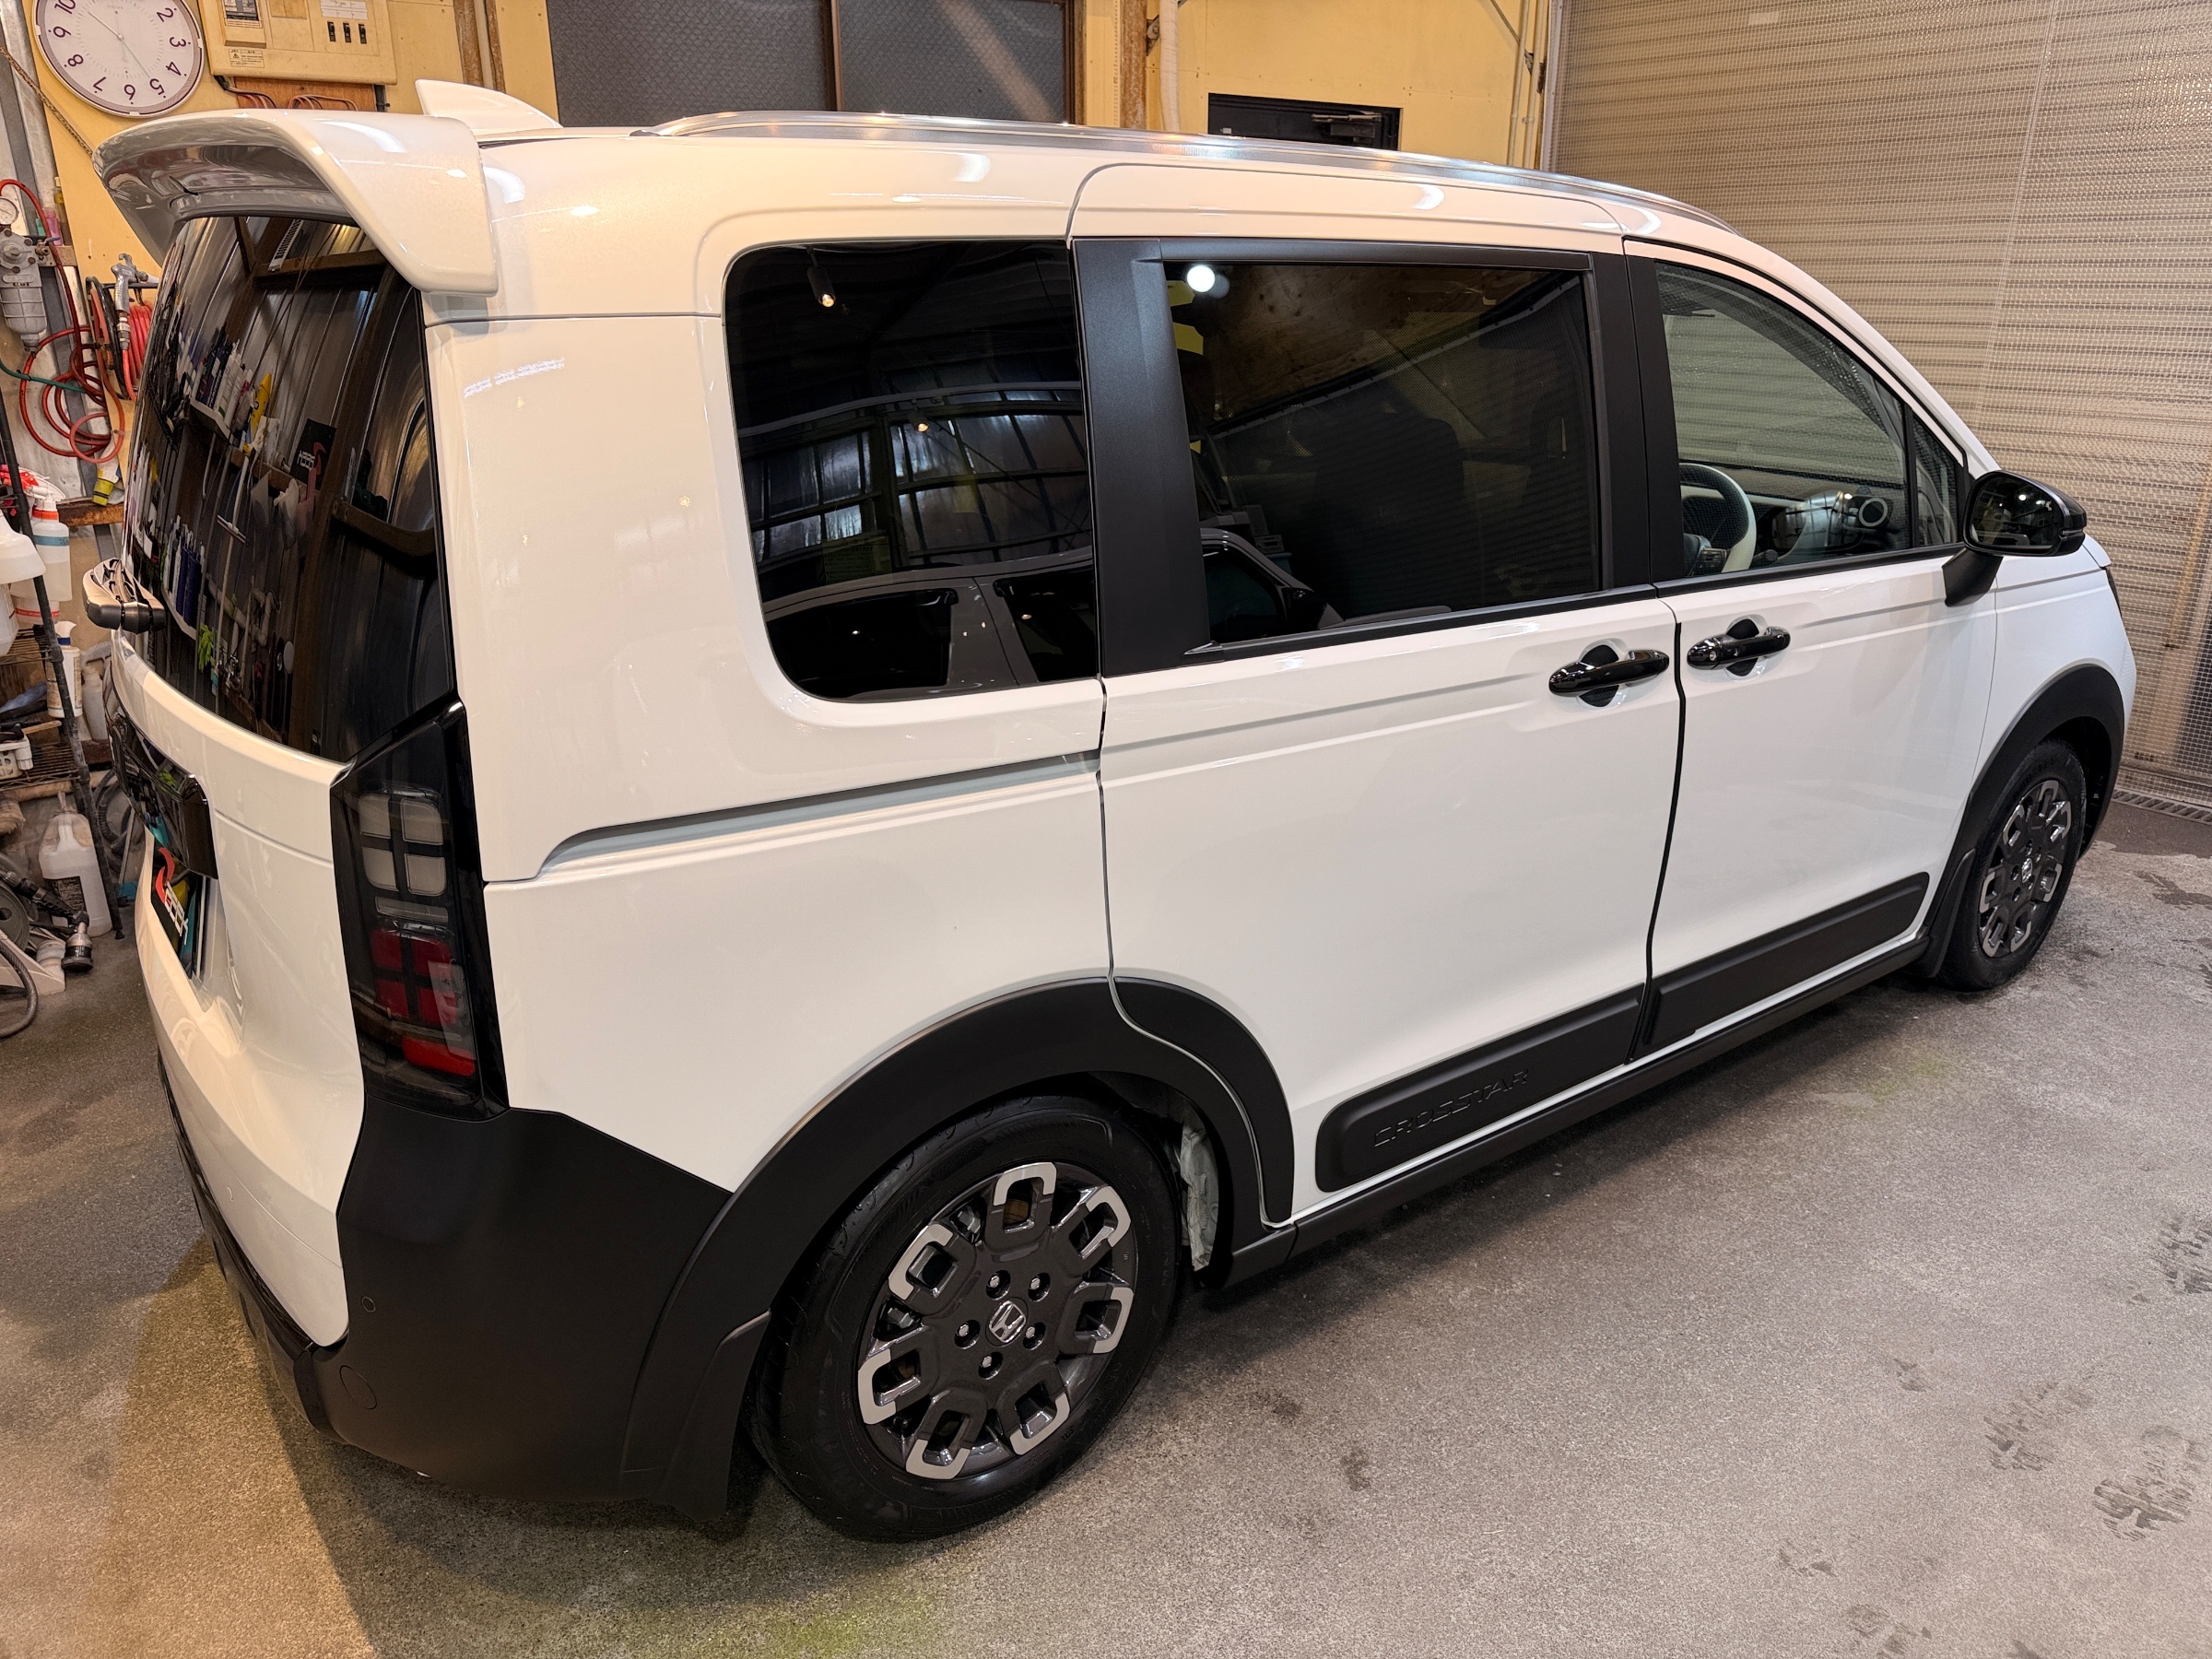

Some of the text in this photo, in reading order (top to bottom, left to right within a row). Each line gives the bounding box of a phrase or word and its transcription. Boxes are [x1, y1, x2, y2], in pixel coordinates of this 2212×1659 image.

[53, 0, 76, 15] 10
[156, 7, 174, 23] 2
[53, 26, 72, 39] 9
[169, 36, 186, 48] 3
[66, 53, 84, 67] 8
[165, 61, 182, 76] 4
[92, 76, 107, 92] 7
[149, 78, 166, 96] 5
[124, 84, 136, 100] 6
[1374, 1067, 1529, 1147] CROSSTAR
